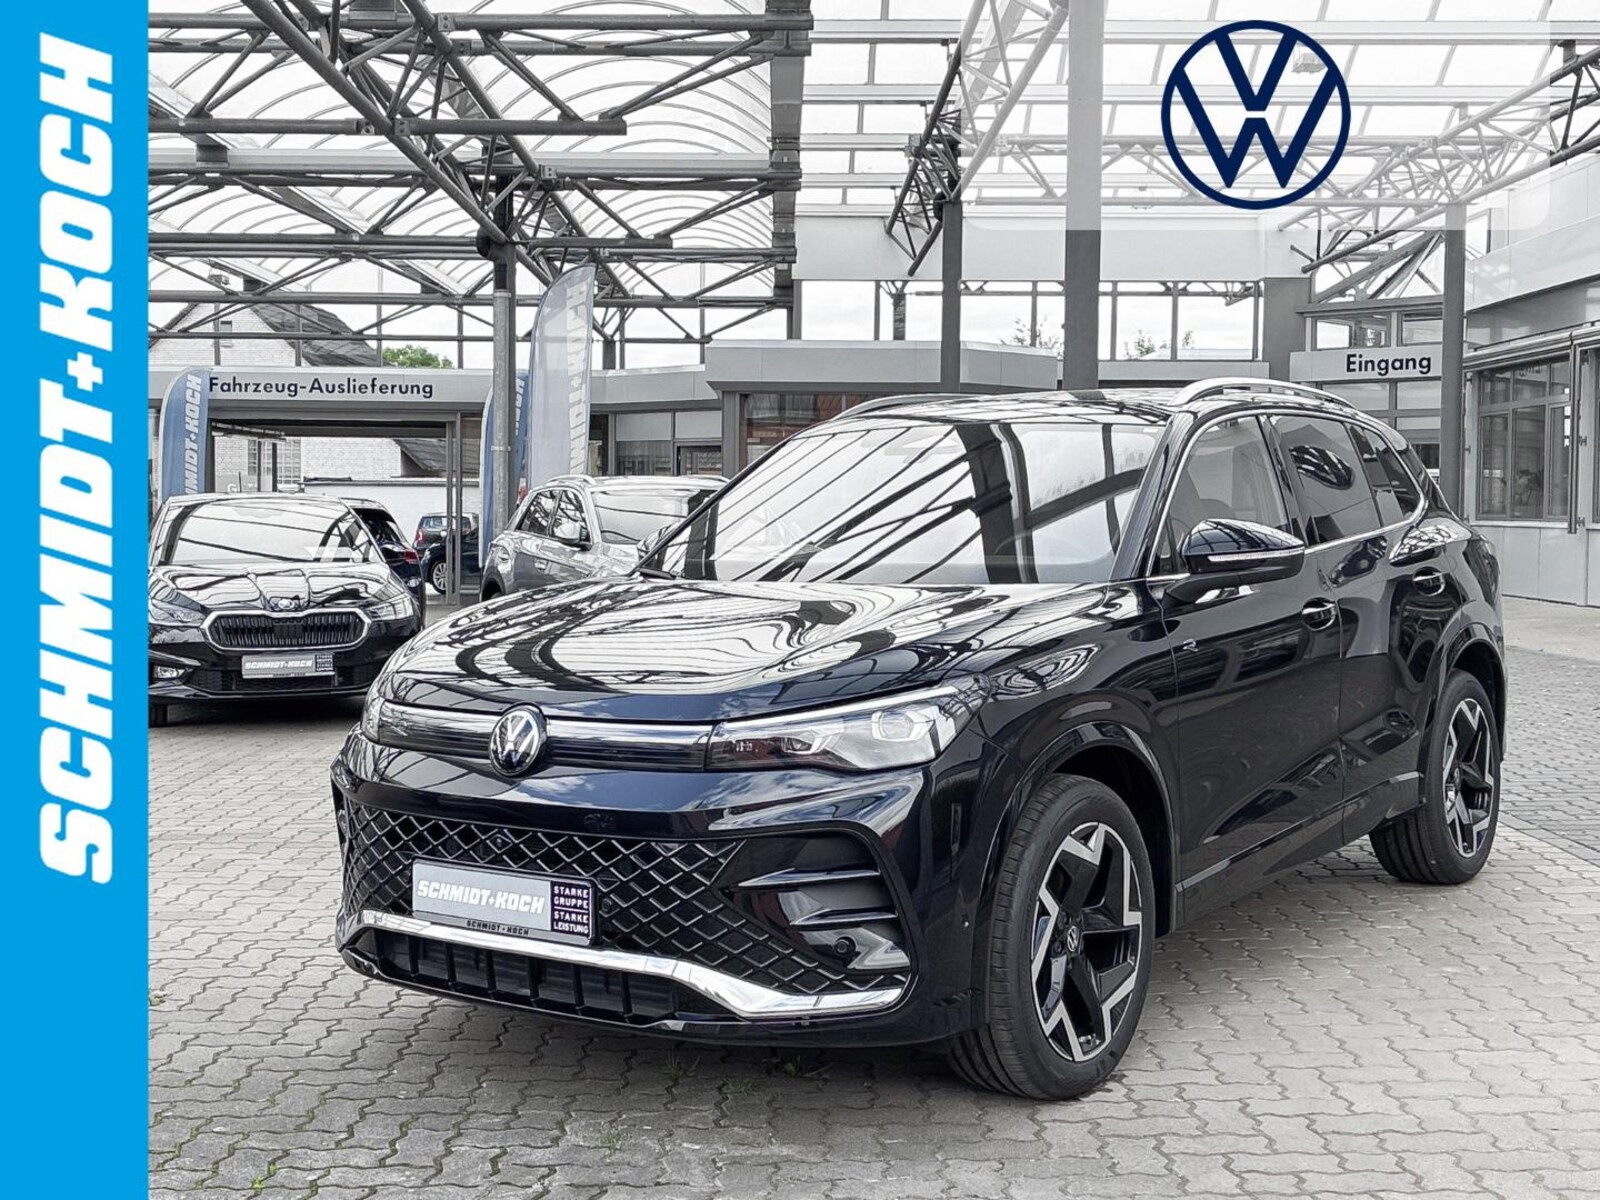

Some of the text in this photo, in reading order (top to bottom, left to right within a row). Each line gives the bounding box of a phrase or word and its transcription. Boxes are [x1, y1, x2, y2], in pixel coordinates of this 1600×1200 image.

[1346, 353, 1431, 376] Eingang
[208, 376, 434, 398] Fahrzeug-Auslieferung
[417, 879, 545, 914] SCHMIDT+KOCH
[553, 885, 589, 899] STARKE
[553, 895, 589, 909] GRUPPE
[553, 911, 589, 924] STARKE
[466, 920, 501, 932] SCHMIDT
[506, 926, 530, 936] KOCH
[553, 922, 589, 934] LEISTUNG
